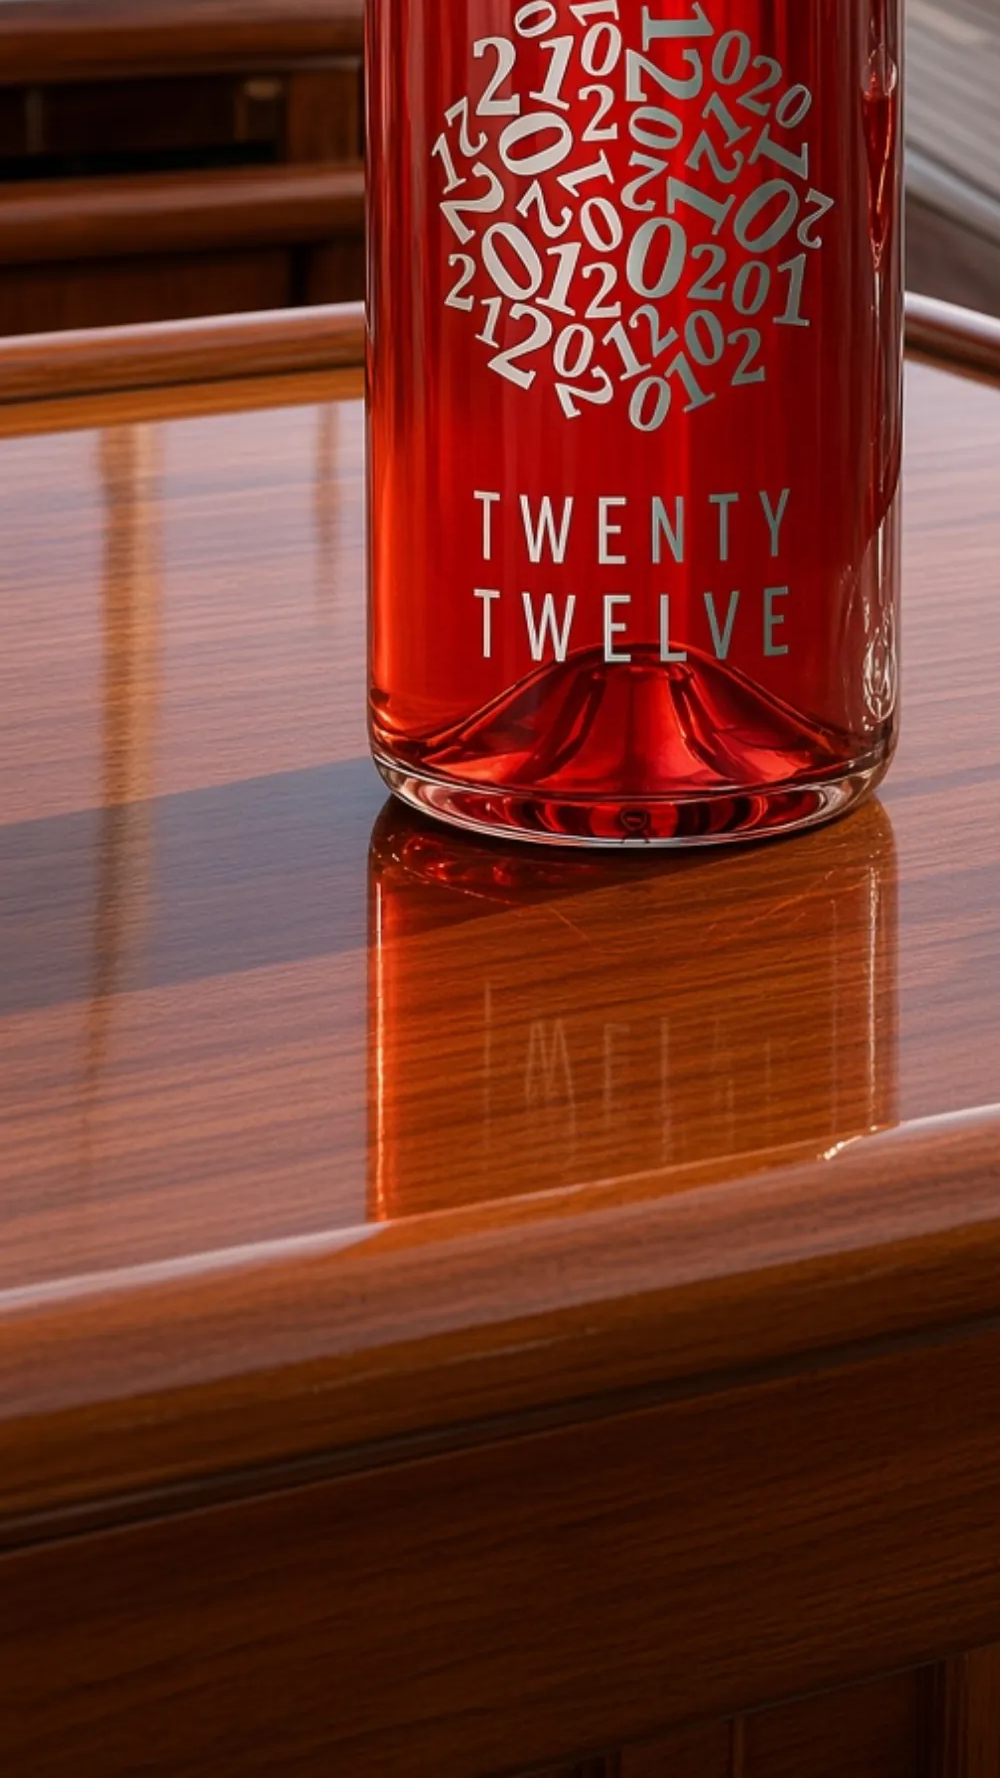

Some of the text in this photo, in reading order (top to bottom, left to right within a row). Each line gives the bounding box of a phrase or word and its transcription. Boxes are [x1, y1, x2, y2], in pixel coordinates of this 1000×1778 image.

[513, 0, 557, 39] 0
[580, 21, 623, 77] 0
[641, 1, 714, 52] 1
[472, 35, 521, 116] 2
[528, 34, 575, 111] 1
[624, 47, 703, 103] 2
[711, 29, 751, 85] 0
[736, 54, 782, 116] 2
[443, 95, 489, 158] 2
[577, 83, 619, 143] 2
[628, 105, 683, 150] 0
[702, 91, 751, 148] 1
[775, 82, 812, 128] 0
[431, 132, 467, 195] 1
[497, 110, 574, 176] 0
[685, 130, 743, 184] 2
[748, 124, 809, 180] 1
[555, 148, 615, 198] 1
[620, 150, 669, 212] 2
[439, 161, 505, 245] 2
[515, 178, 574, 239] 2
[579, 196, 624, 253] 0
[666, 175, 736, 236] 1
[733, 180, 798, 252] 0
[797, 188, 835, 249] 2
[443, 253, 477, 312] 2
[481, 221, 544, 301] 0
[534, 241, 582, 317] 1
[625, 216, 687, 299] 0
[687, 244, 726, 300] 2
[581, 261, 622, 319] 2
[732, 260, 770, 315] 0
[773, 253, 810, 327] 1
[474, 295, 503, 349] 1
[486, 302, 554, 391] 2
[552, 322, 595, 378] 0
[601, 320, 652, 382] 1
[628, 303, 679, 358] 2
[684, 309, 724, 366] 0
[664, 351, 715, 413] 1
[727, 328, 766, 386] 2
[554, 364, 614, 419] 2
[628, 376, 672, 432] 0
[472, 488, 790, 564] TWENTY
[472, 586, 789, 662] TWELVE
